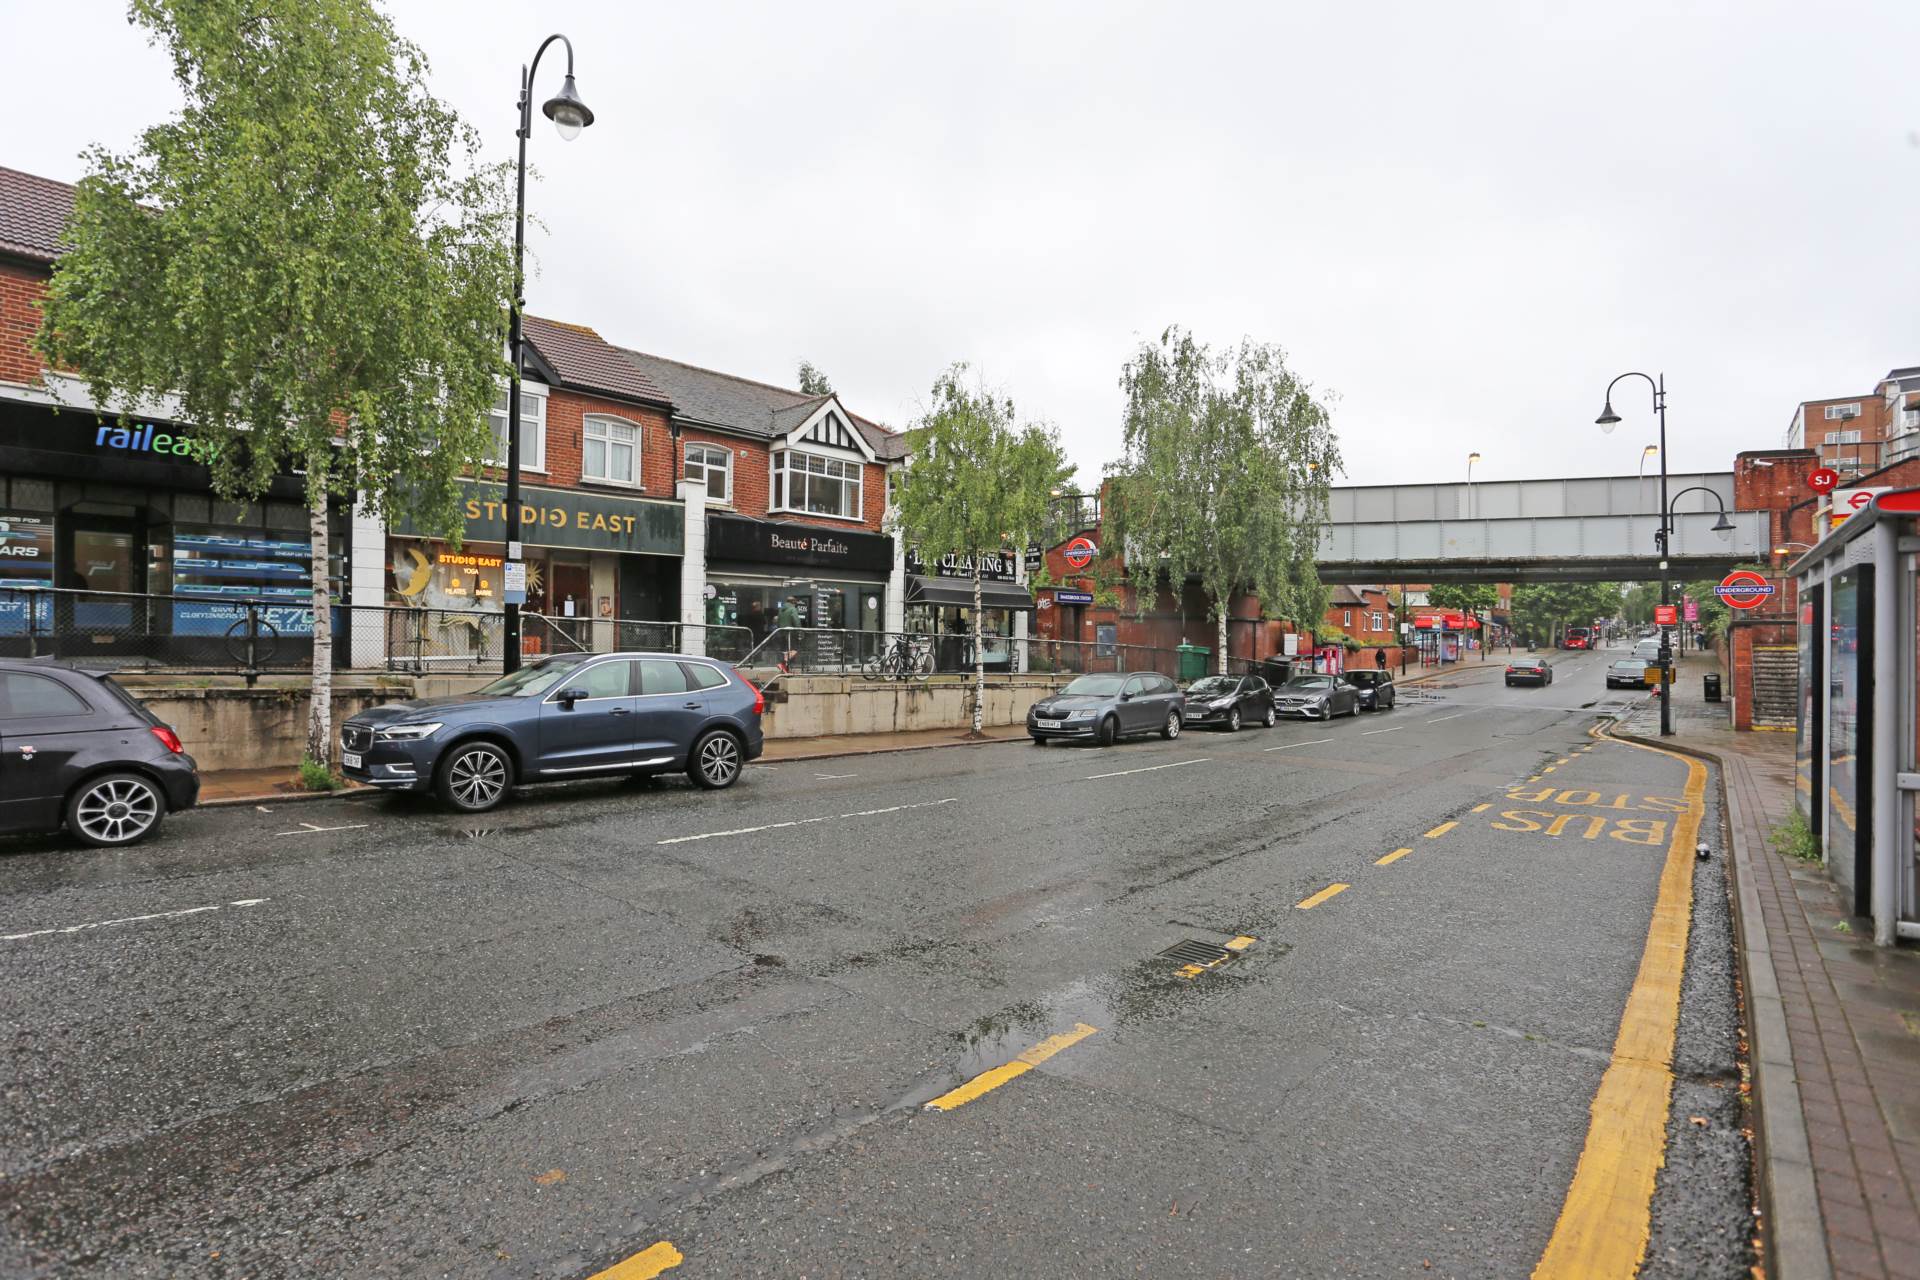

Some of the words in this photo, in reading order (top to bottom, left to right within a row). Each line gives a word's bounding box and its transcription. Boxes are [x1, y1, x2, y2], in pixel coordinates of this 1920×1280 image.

[1815, 475, 1830, 485] SJ
[577, 511, 636, 533] EAST
[771, 533, 807, 550] Beauté
[810, 537, 848, 554] Parfaite
[439, 554, 476, 565] STUDIO
[477, 557, 502, 567] EAST
[1505, 788, 1690, 813] STOP
[1490, 810, 1668, 846] BUS
